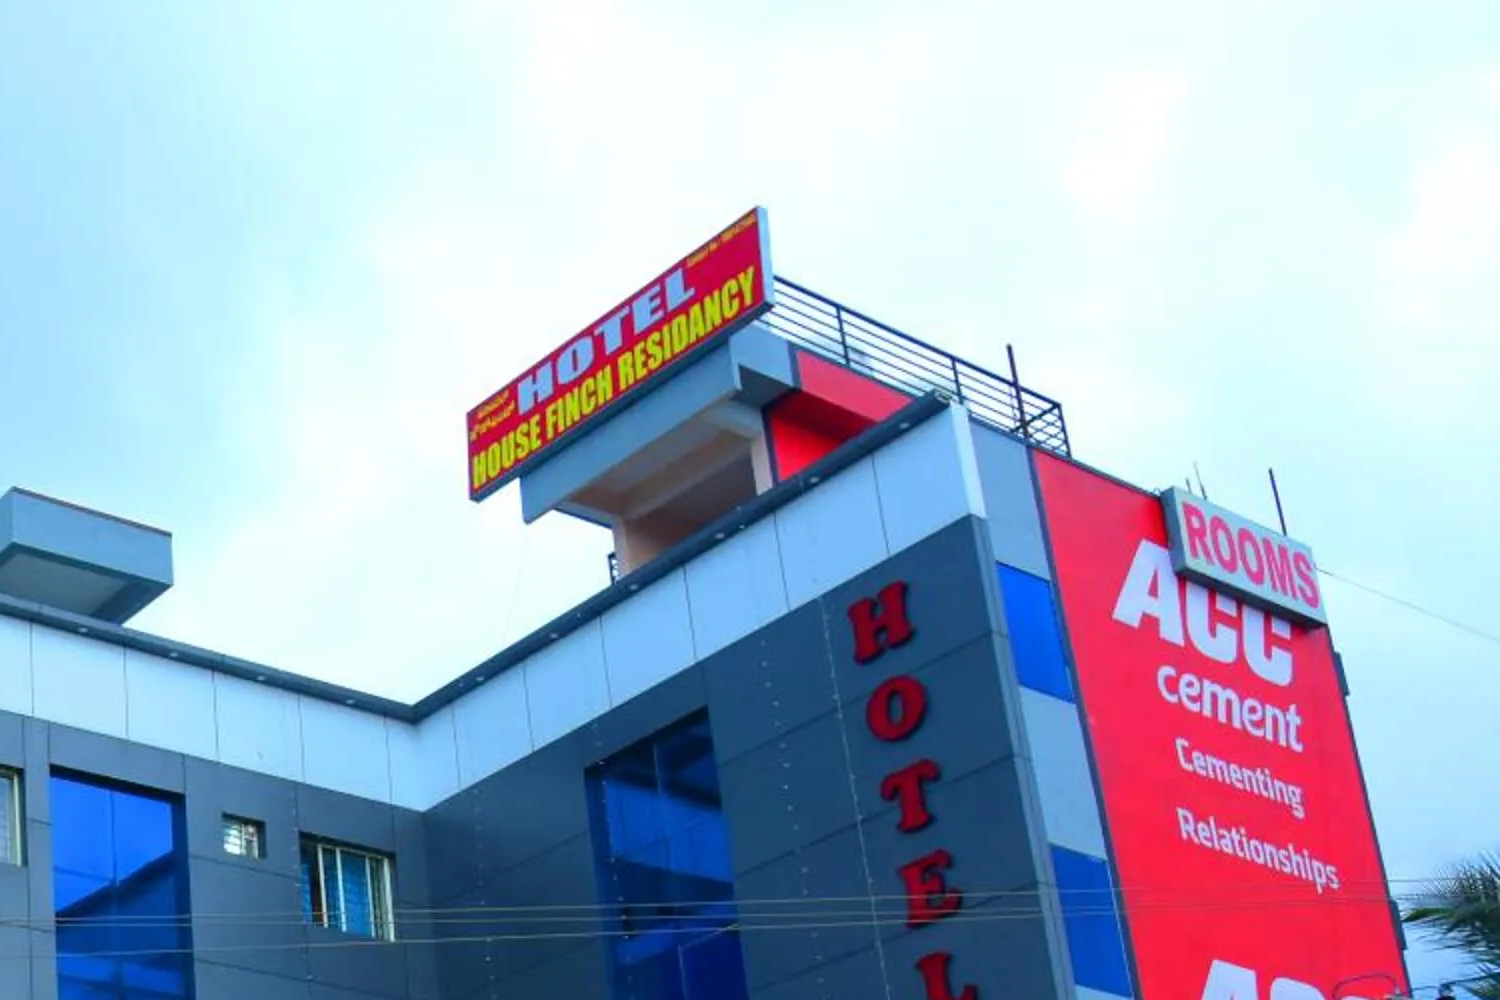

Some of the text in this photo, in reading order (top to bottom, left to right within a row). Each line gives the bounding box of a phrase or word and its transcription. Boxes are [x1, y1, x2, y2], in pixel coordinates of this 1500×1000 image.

[472, 415, 541, 490] HOUSE
[546, 364, 613, 439] FINCH
[617, 265, 756, 391] RESIDANCY
[517, 267, 695, 416] HOTEL
[1182, 500, 1320, 610] ROOMS
[1112, 538, 1293, 687] ACC
[1157, 664, 1304, 752] cement
[1174, 737, 1305, 820] Cementing
[1176, 807, 1340, 895] Relationships
